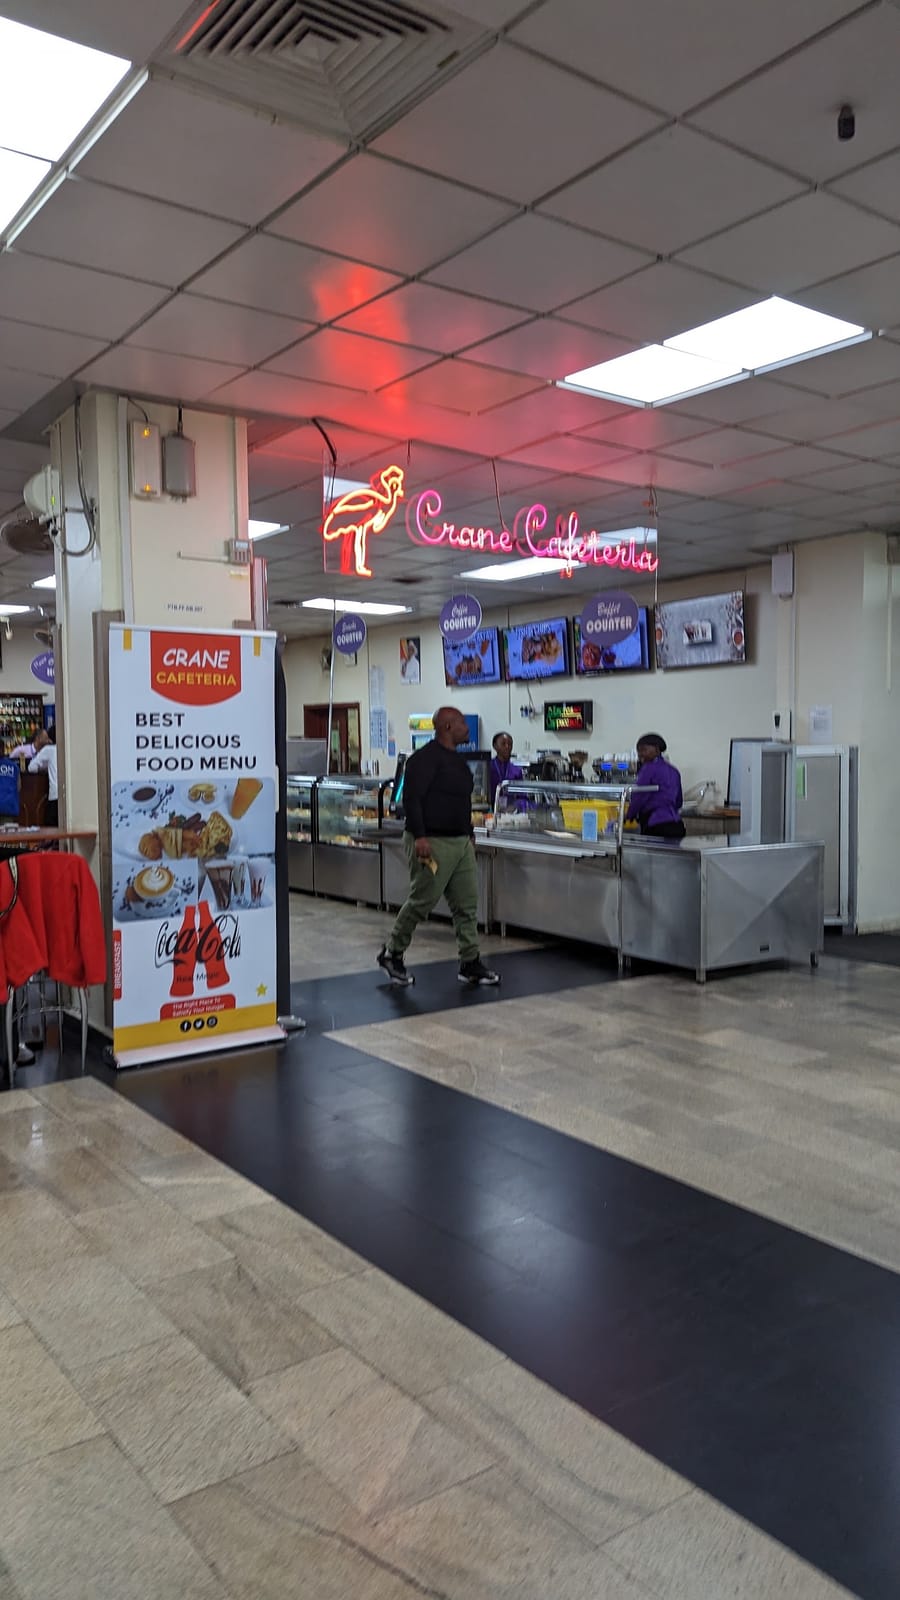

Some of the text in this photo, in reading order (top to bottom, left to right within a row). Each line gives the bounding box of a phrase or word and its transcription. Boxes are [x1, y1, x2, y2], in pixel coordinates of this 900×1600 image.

[415, 490, 659, 577] Crane Cafeteria
[598, 602, 621, 617] Buffet
[444, 616, 476, 631] COUNTER
[587, 616, 632, 633] COUNTER
[337, 631, 362, 646] COUNTER
[163, 648, 230, 669] CRANE
[156, 671, 237, 686] CAFETERIA
[136, 712, 185, 728] BEST
[136, 734, 241, 750] DELICIOUS
[136, 755, 257, 772] FOOD MENU
